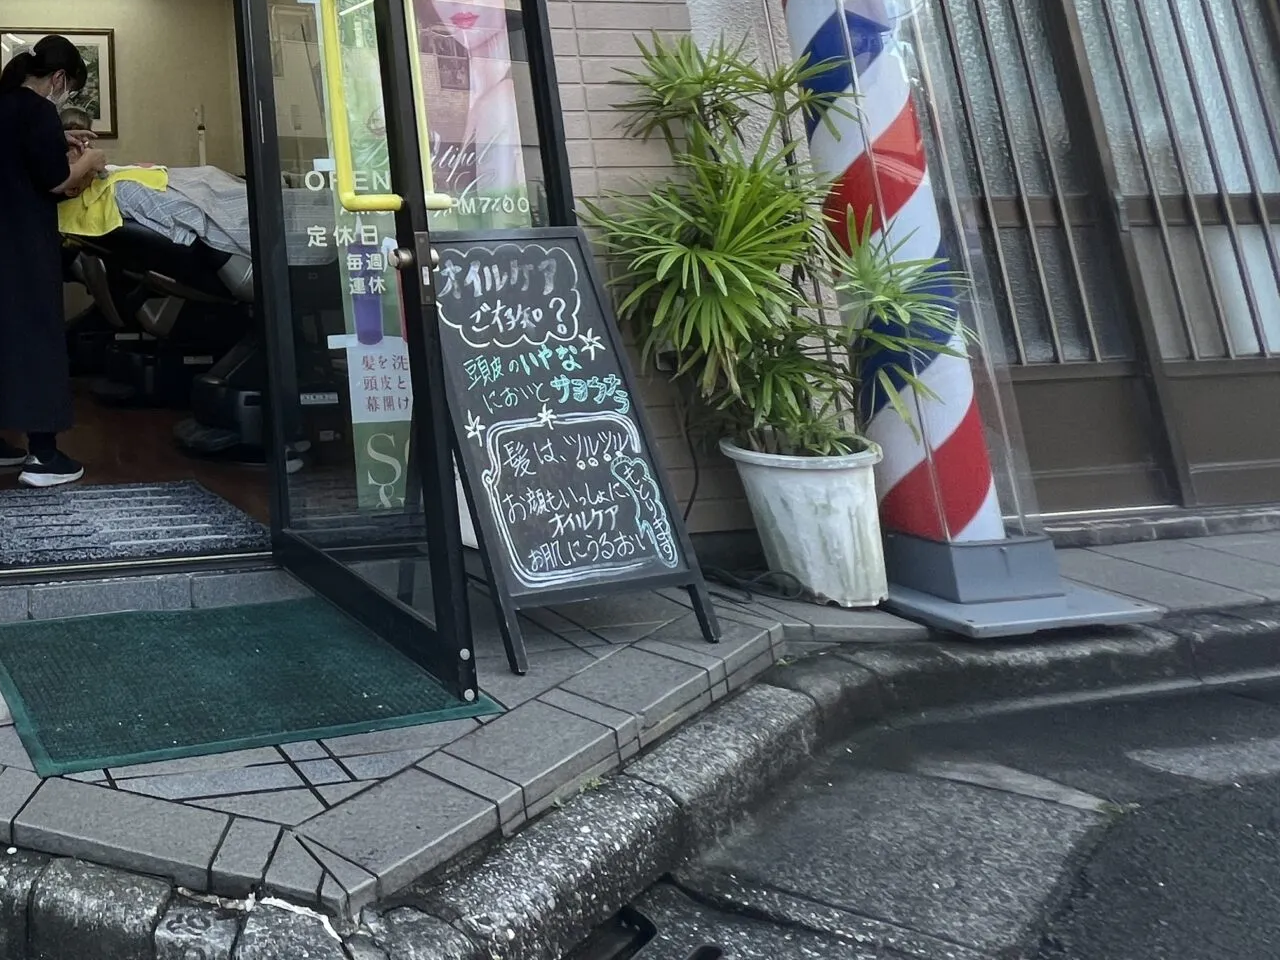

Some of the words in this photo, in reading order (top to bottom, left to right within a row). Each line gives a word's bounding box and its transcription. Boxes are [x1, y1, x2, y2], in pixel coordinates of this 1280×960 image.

[307, 225, 379, 247] 定休日
[346, 253, 383, 271] 毎週
[349, 276, 386, 295] 連休
[437, 259, 557, 299] オイルケア
[463, 344, 583, 391] 頭皮のいやな
[363, 375, 407, 391] 頭皮と
[366, 396, 409, 413] 幕開け
[367, 433, 410, 487] S
[548, 505, 619, 538] オイルケア
[528, 531, 646, 572] お肌にうるおい
